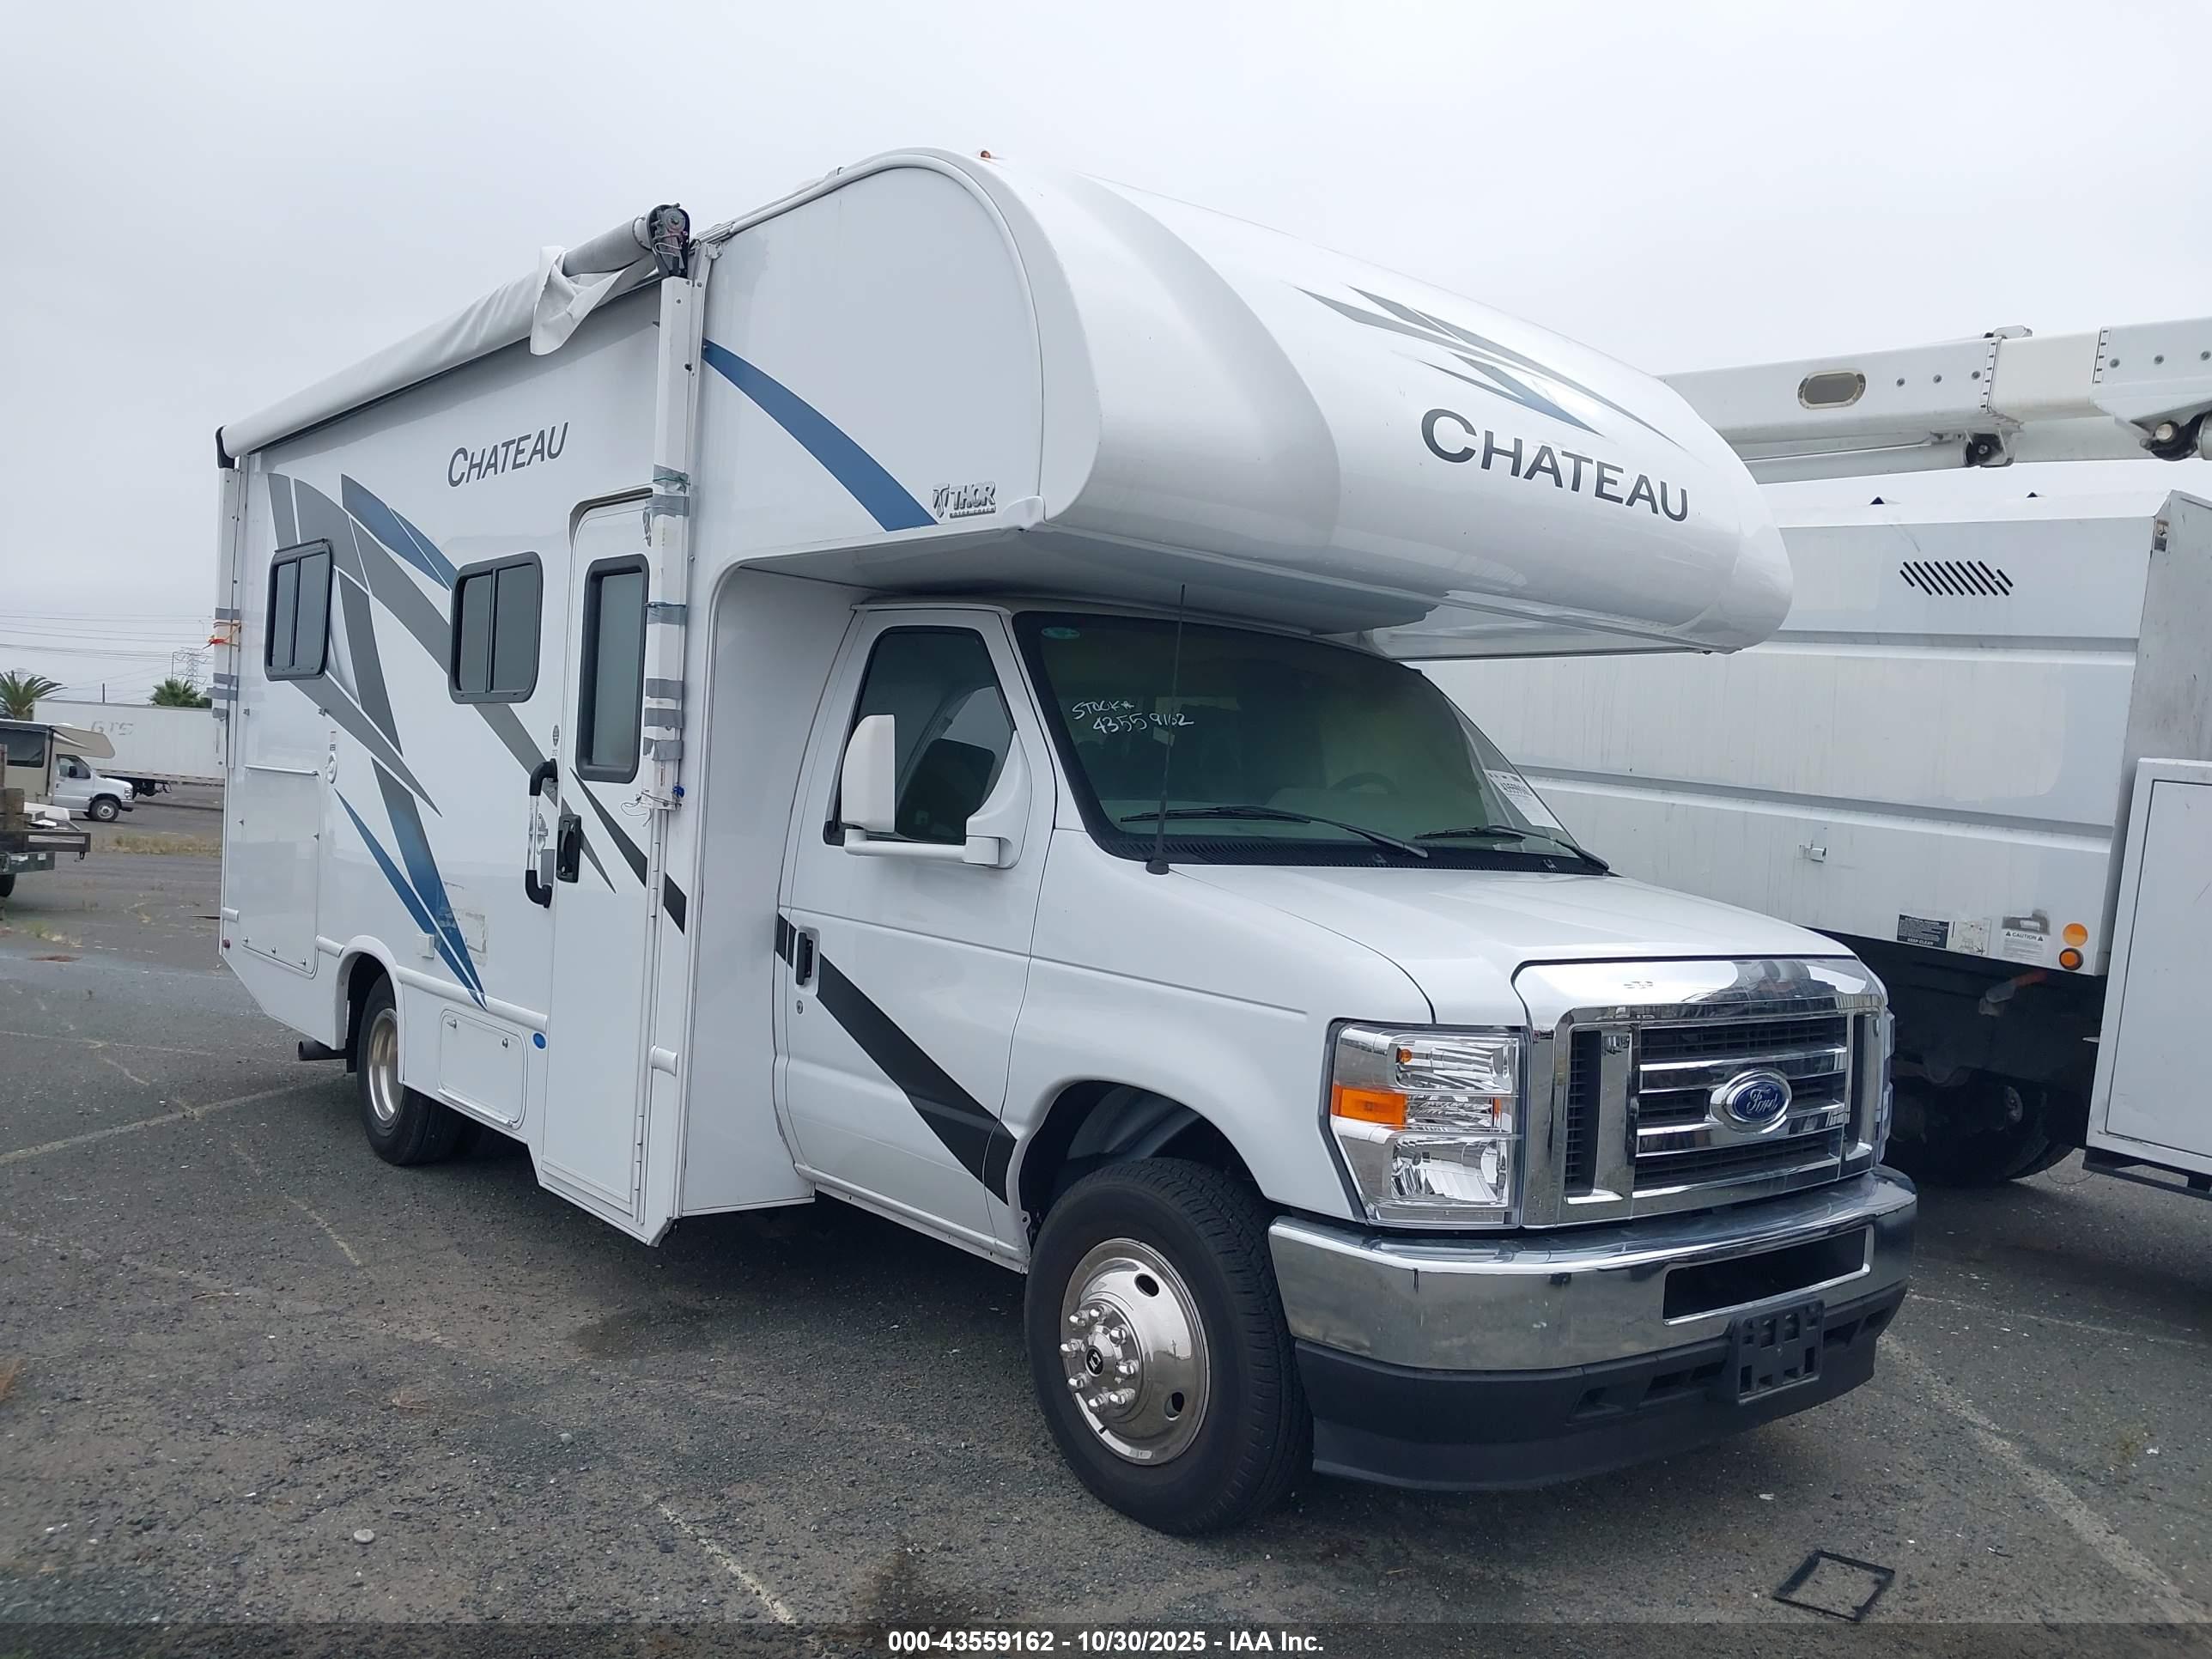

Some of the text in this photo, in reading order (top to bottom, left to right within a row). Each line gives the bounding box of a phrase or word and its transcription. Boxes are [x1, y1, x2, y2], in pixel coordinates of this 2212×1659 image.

[447, 422, 568, 488] CHATEAU
[1420, 408, 1689, 522] CHATEAU
[950, 481, 996, 511] THOR
[2012, 932, 2038, 941] CAUTION
[1746, 1087, 1778, 1115] Ford
